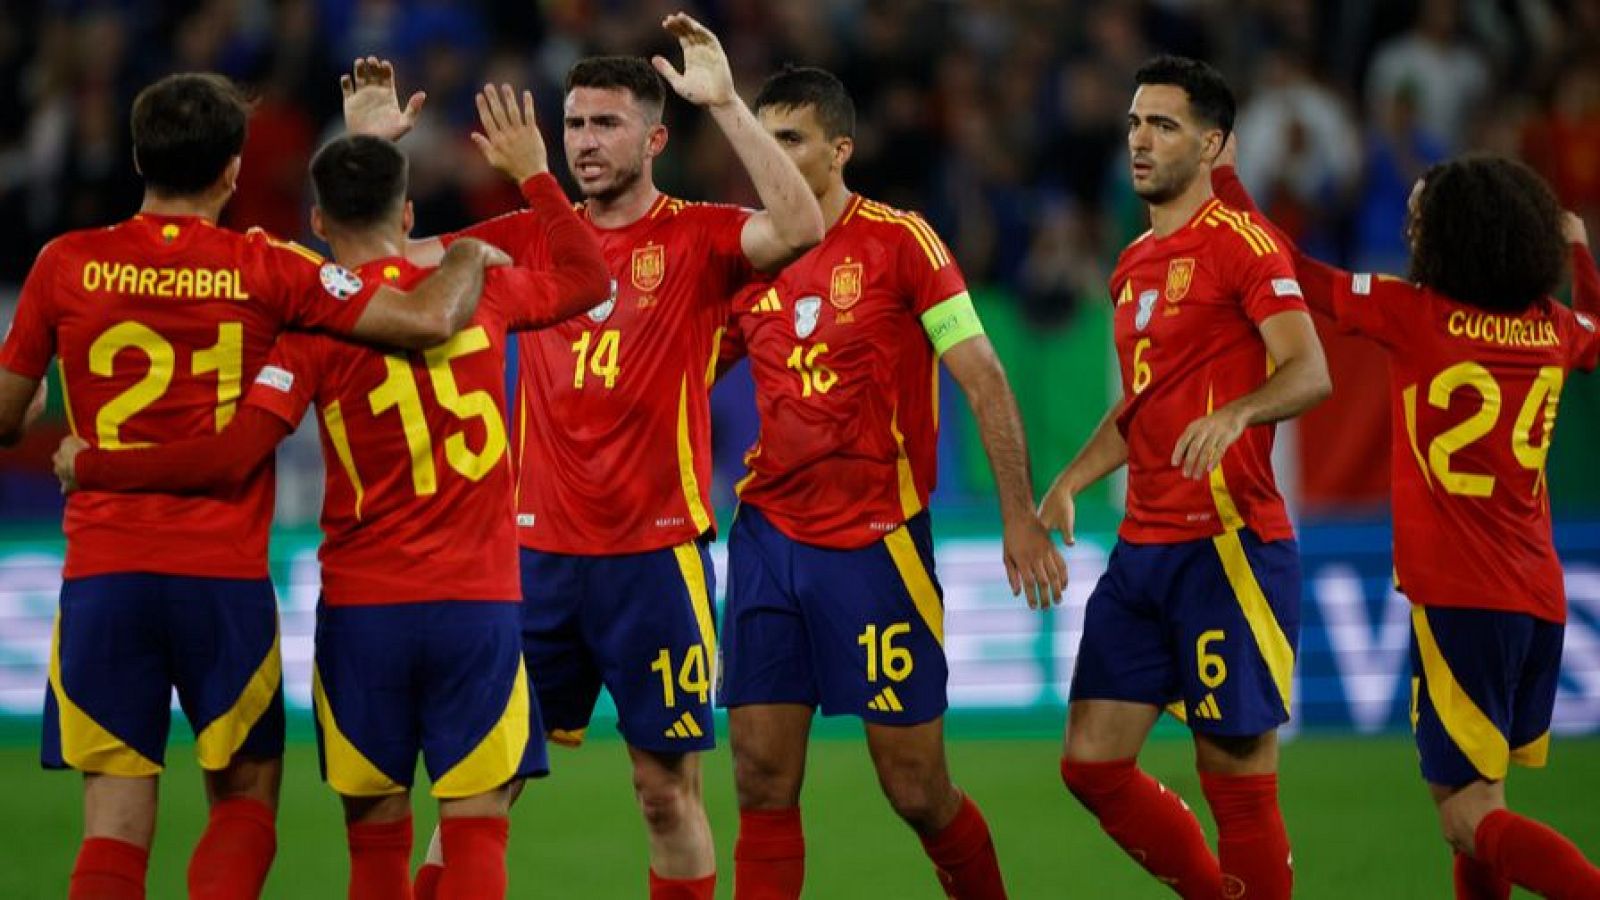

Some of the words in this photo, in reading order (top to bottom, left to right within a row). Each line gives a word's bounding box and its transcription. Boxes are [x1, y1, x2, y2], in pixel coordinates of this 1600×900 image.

[83, 260, 248, 301] OYARZABAL
[1448, 310, 1559, 346] CUCURELLA
[89, 320, 243, 451] 21
[571, 329, 620, 389] 14
[787, 342, 838, 398] 16
[1133, 338, 1152, 394] 6
[368, 326, 509, 497] 15
[1428, 361, 1564, 498] 24
[651, 644, 709, 708] 14
[858, 622, 914, 683] 16
[1197, 630, 1226, 688] 6
